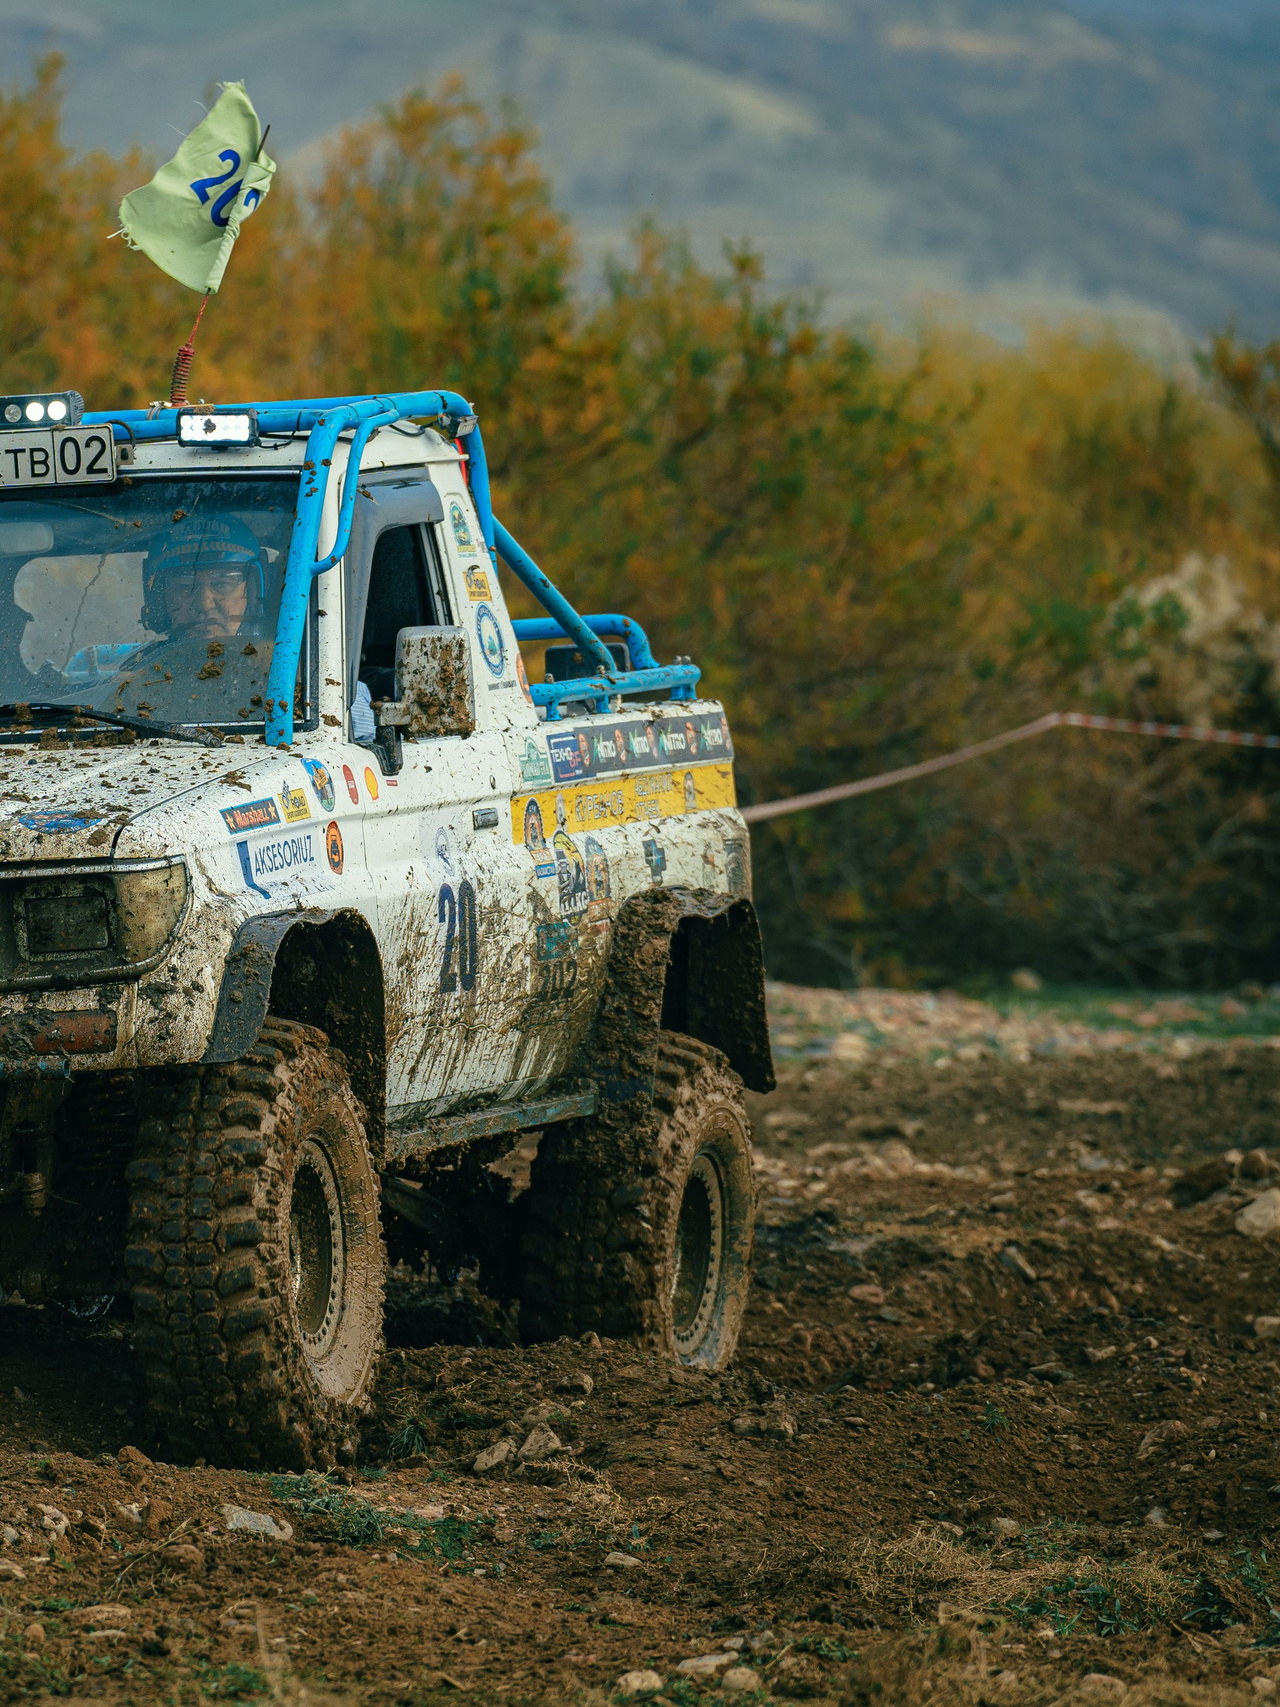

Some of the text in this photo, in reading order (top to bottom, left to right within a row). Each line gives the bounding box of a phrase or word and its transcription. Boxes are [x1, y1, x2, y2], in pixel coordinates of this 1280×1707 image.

[190, 149, 244, 227] 20
[233, 805, 270, 827] Marshall
[254, 835, 314, 876] AKSESORIUZ
[438, 880, 477, 993] 20
